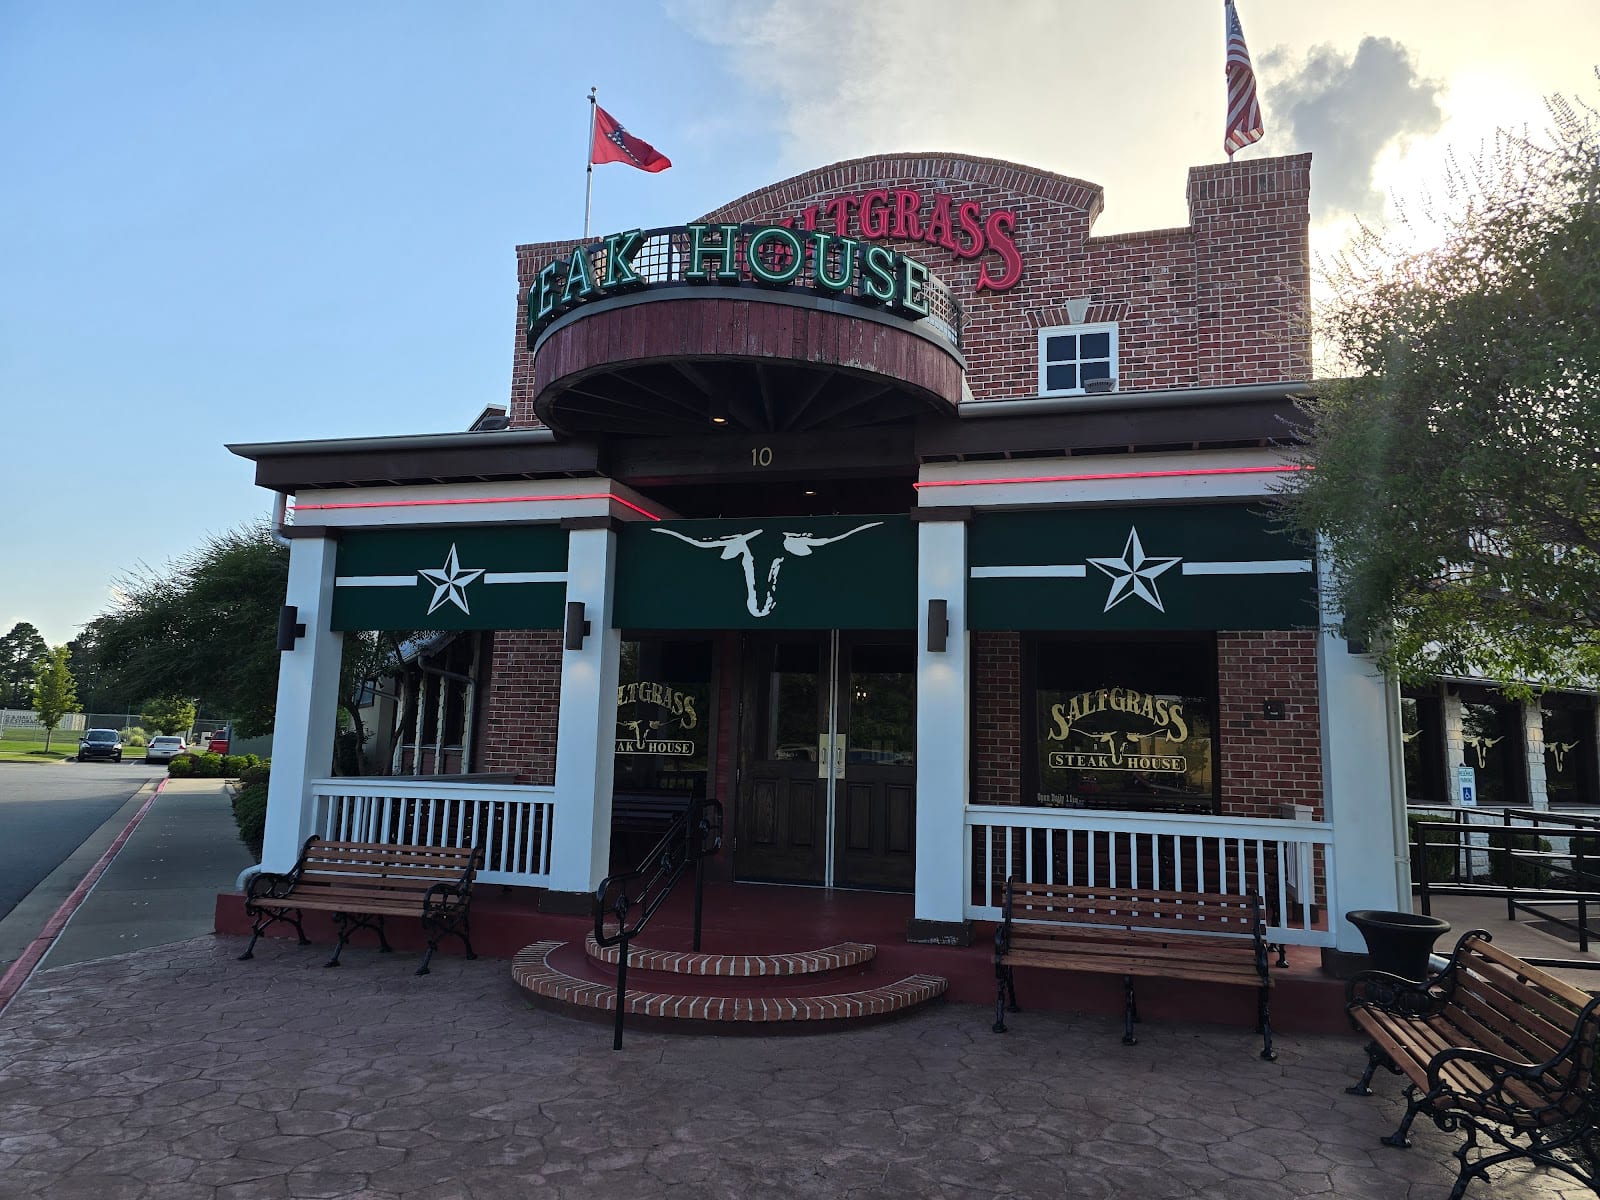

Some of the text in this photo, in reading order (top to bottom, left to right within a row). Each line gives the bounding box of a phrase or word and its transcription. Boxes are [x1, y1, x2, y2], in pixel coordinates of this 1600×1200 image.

[737, 188, 1024, 291] TGRASS
[687, 223, 930, 320] HOUSE
[751, 447, 773, 467] 10
[1048, 687, 1188, 743] SALTGRASS
[648, 742, 690, 753] HOUSE
[1055, 754, 1181, 770] STEAK HOUSE
